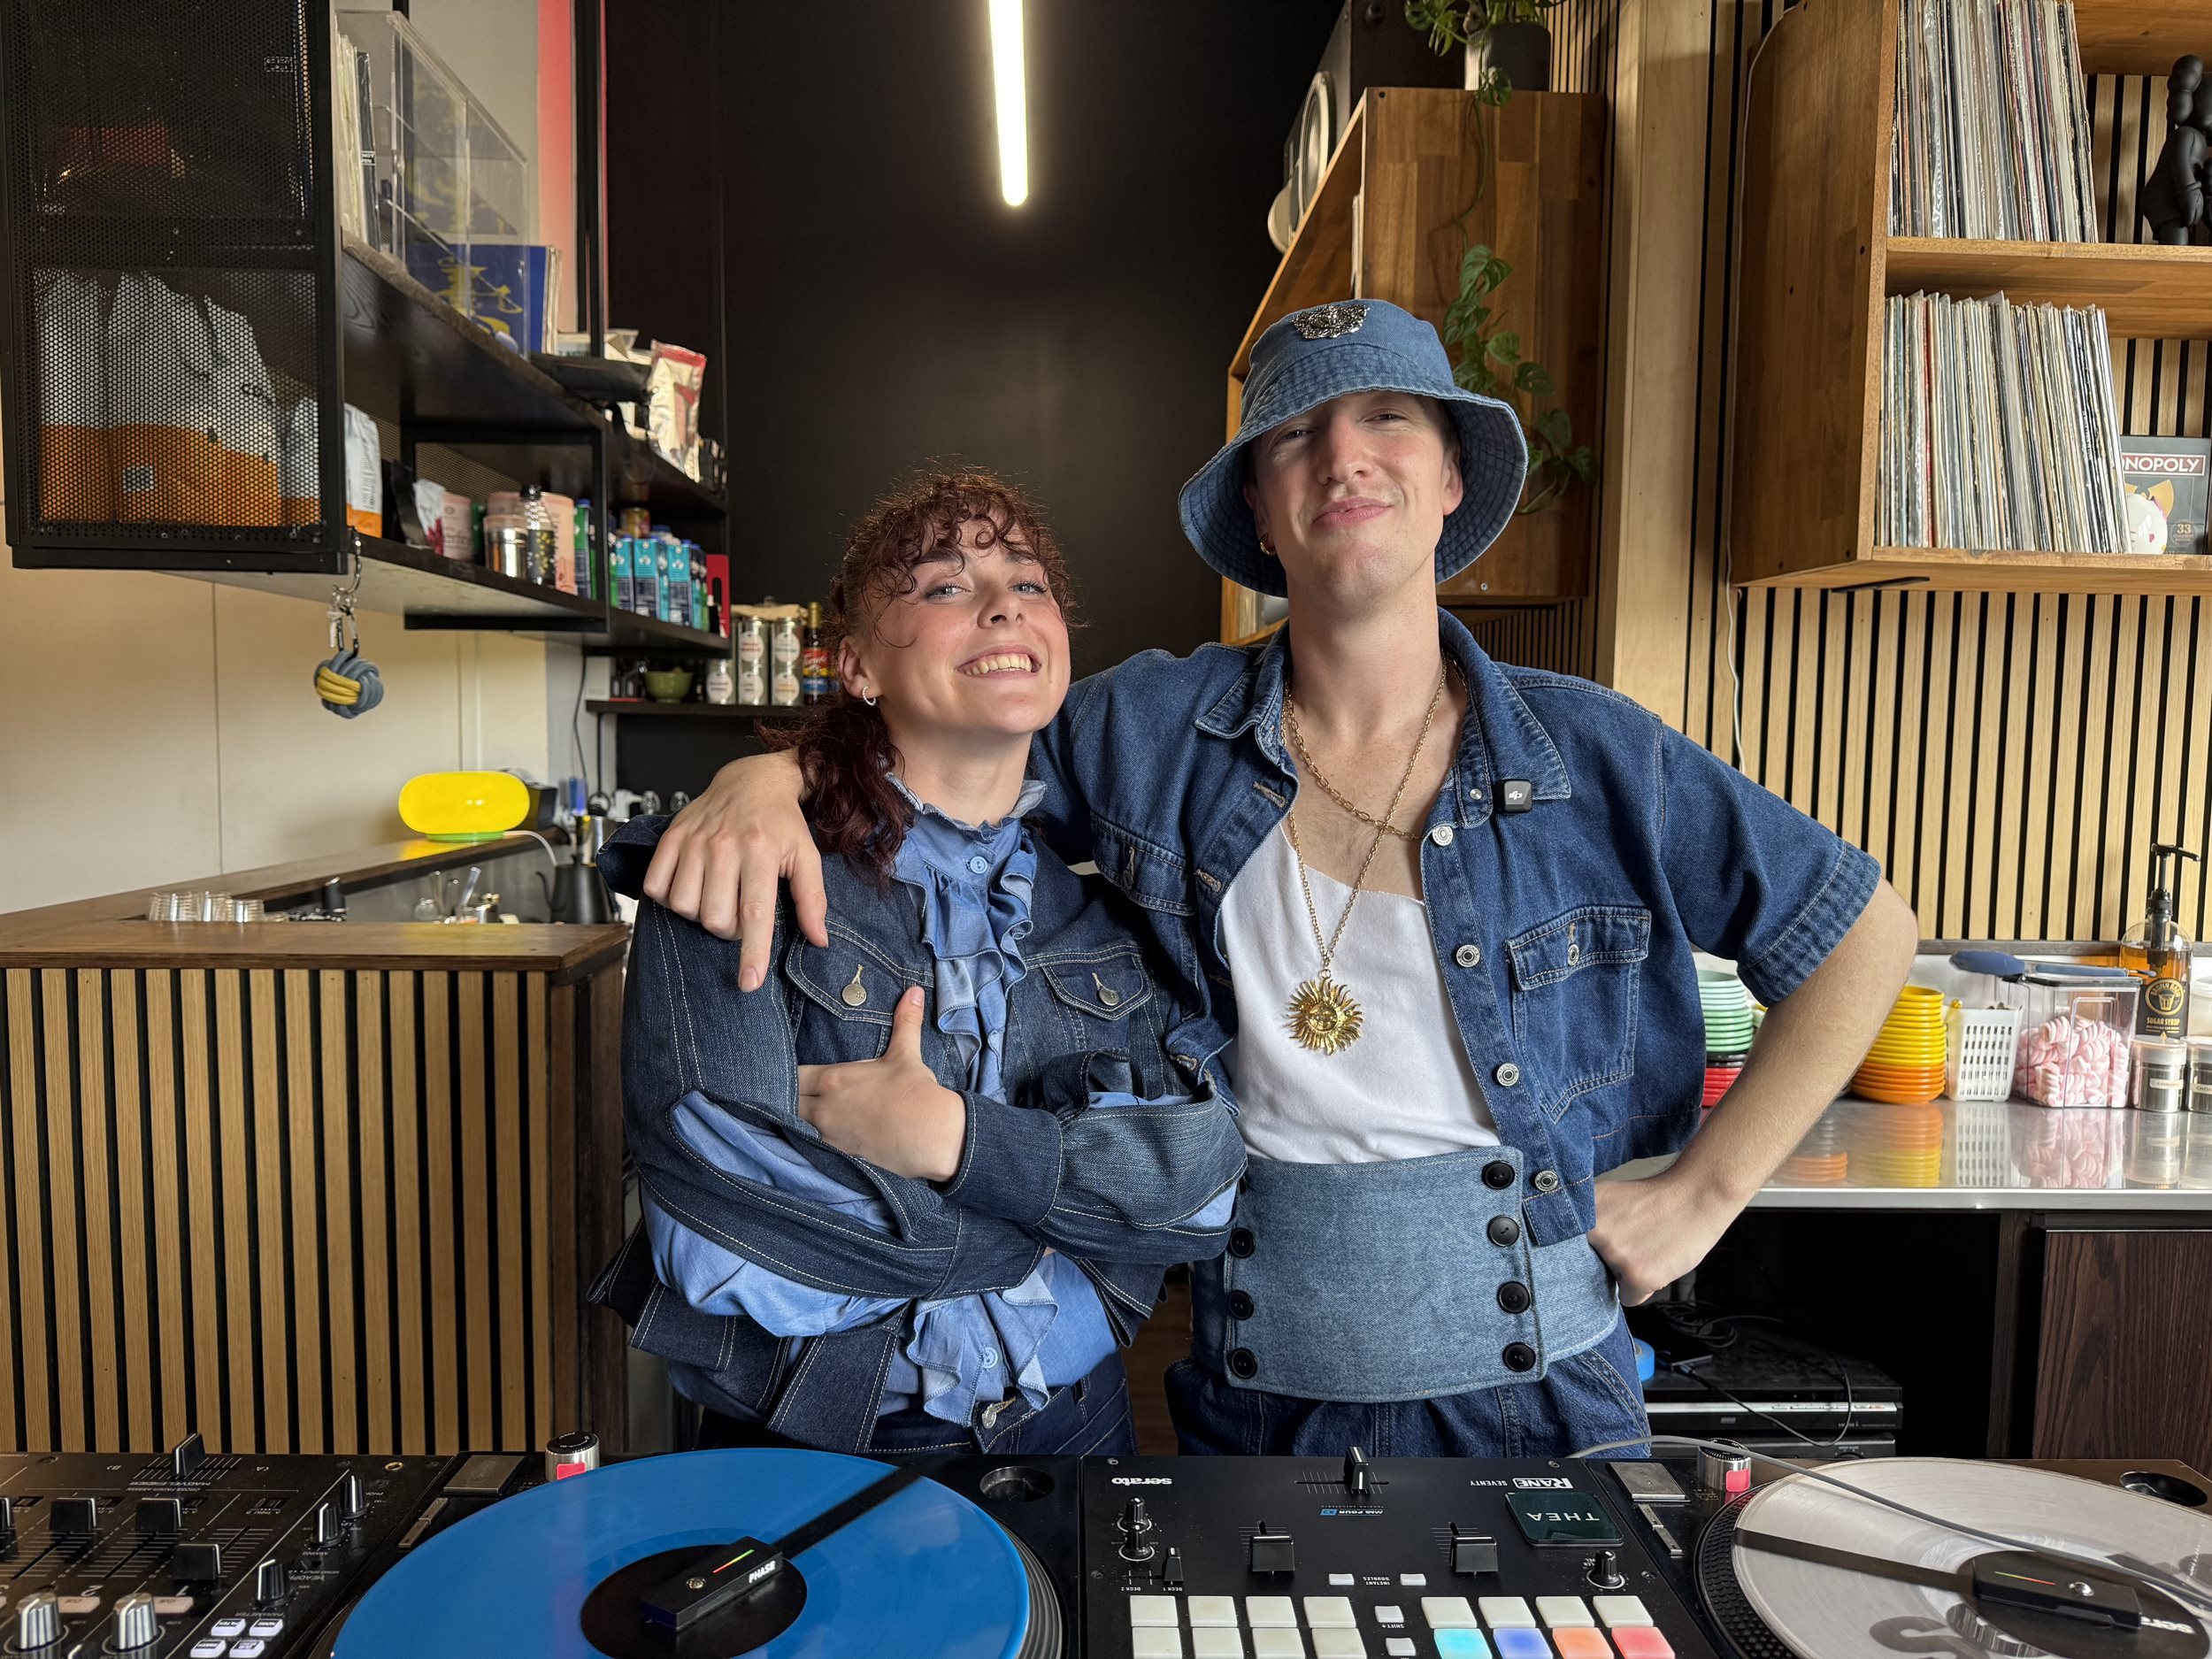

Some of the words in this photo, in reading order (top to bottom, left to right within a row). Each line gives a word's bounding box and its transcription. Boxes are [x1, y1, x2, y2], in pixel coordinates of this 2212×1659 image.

[2177, 523, 2192, 534] 33
[2147, 1017, 2164, 1025] SUGAR
[2164, 1018, 2180, 1026] SYRUP
[1110, 1477, 1173, 1486] serato
[1514, 1478, 1574, 1489] RANE
[1525, 1511, 1601, 1522] THEA
[749, 1560, 777, 1584] PHASE
[81, 1585, 104, 1596] 2
